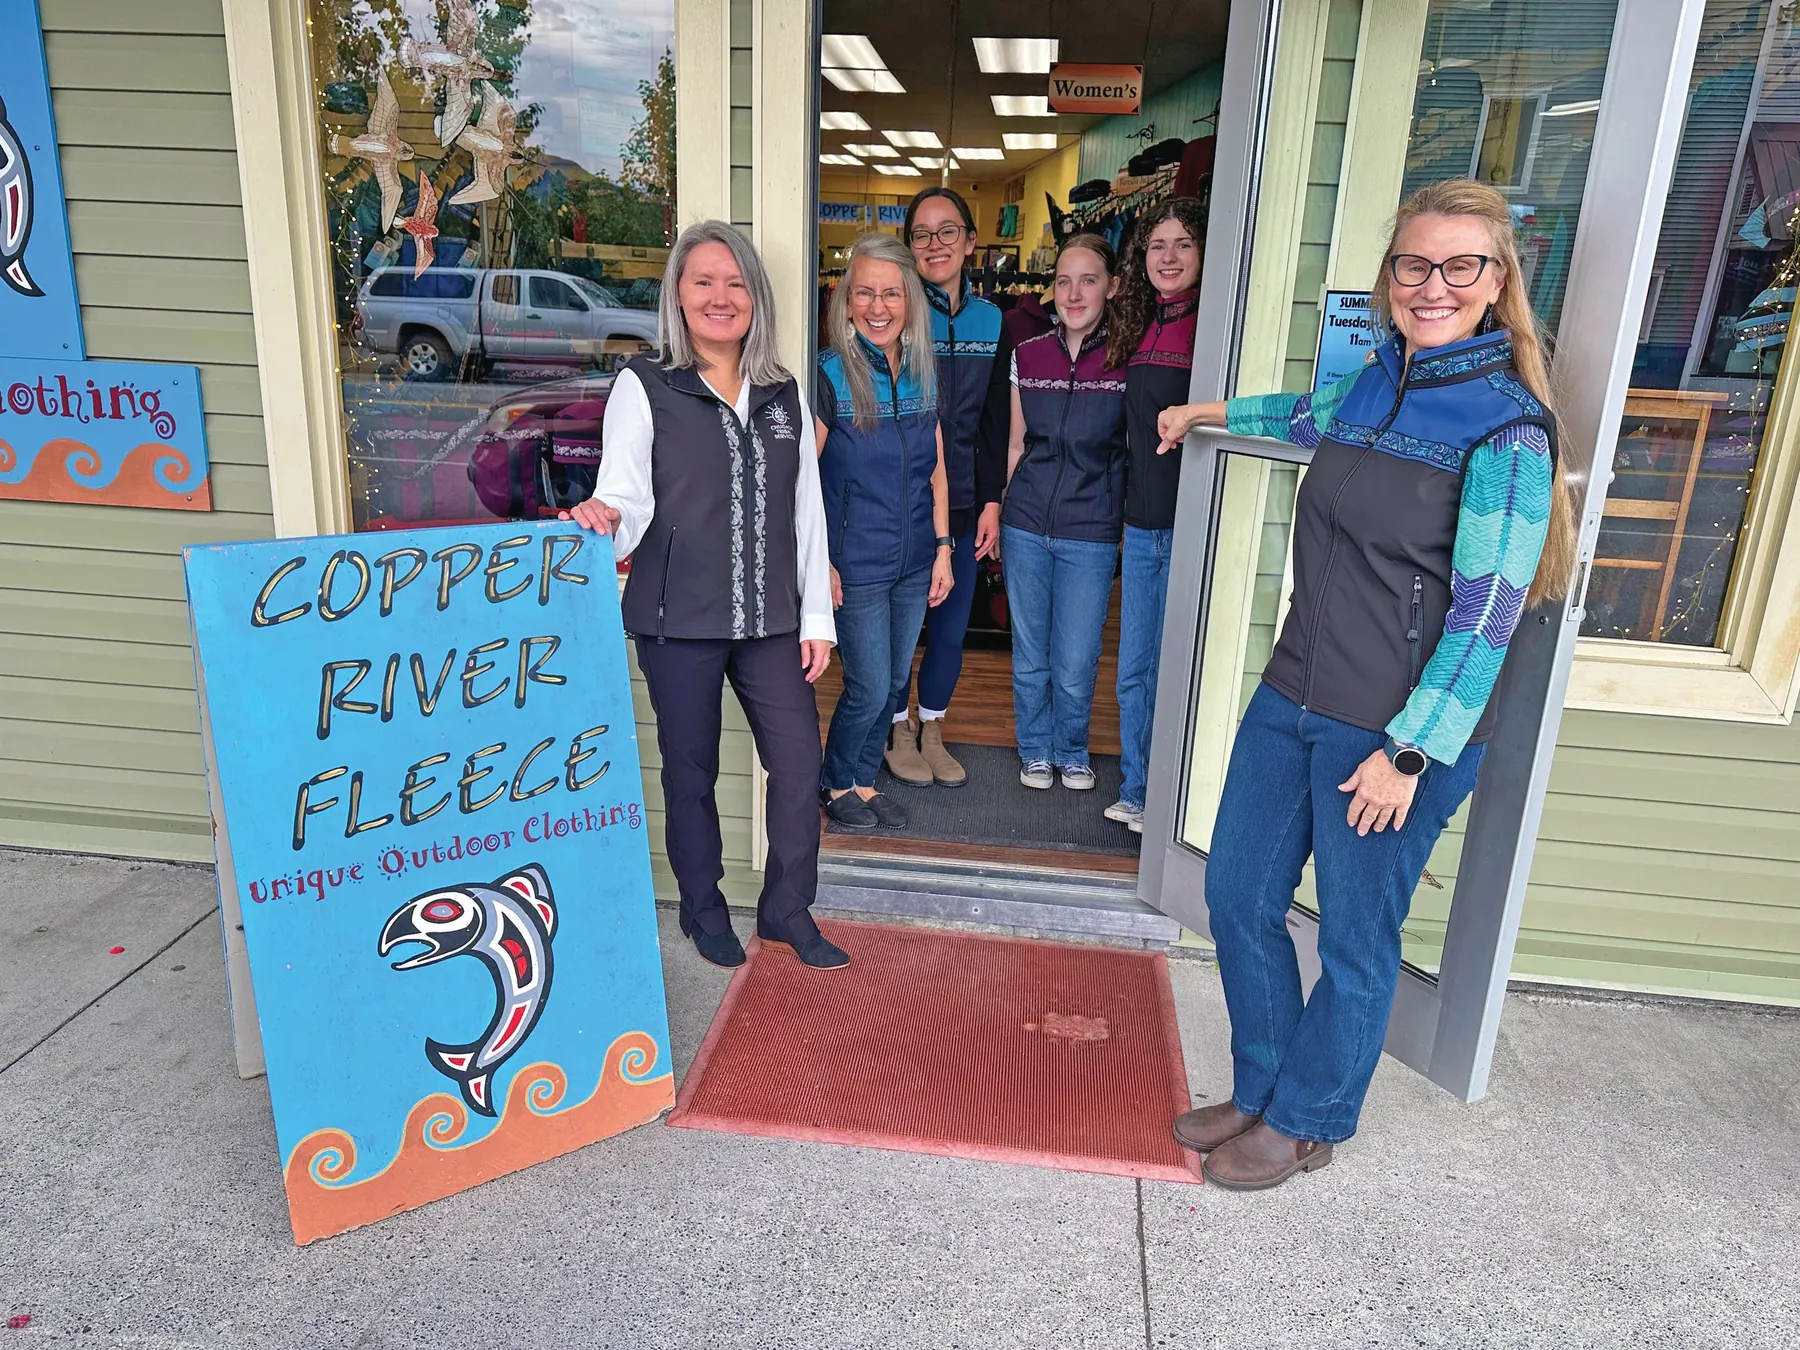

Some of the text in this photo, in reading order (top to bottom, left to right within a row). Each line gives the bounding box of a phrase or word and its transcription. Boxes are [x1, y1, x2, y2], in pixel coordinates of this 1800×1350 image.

[1053, 79, 1137, 99] Women's
[819, 204, 909, 219] OPPE RIV
[1339, 296, 1371, 309] SUMM
[1350, 333, 1371, 346] 11am
[251, 534, 589, 627] COPPER
[317, 635, 567, 740] RIVER
[292, 724, 610, 850] FLEECE
[249, 802, 642, 903] Unique Outdoor Clothing
